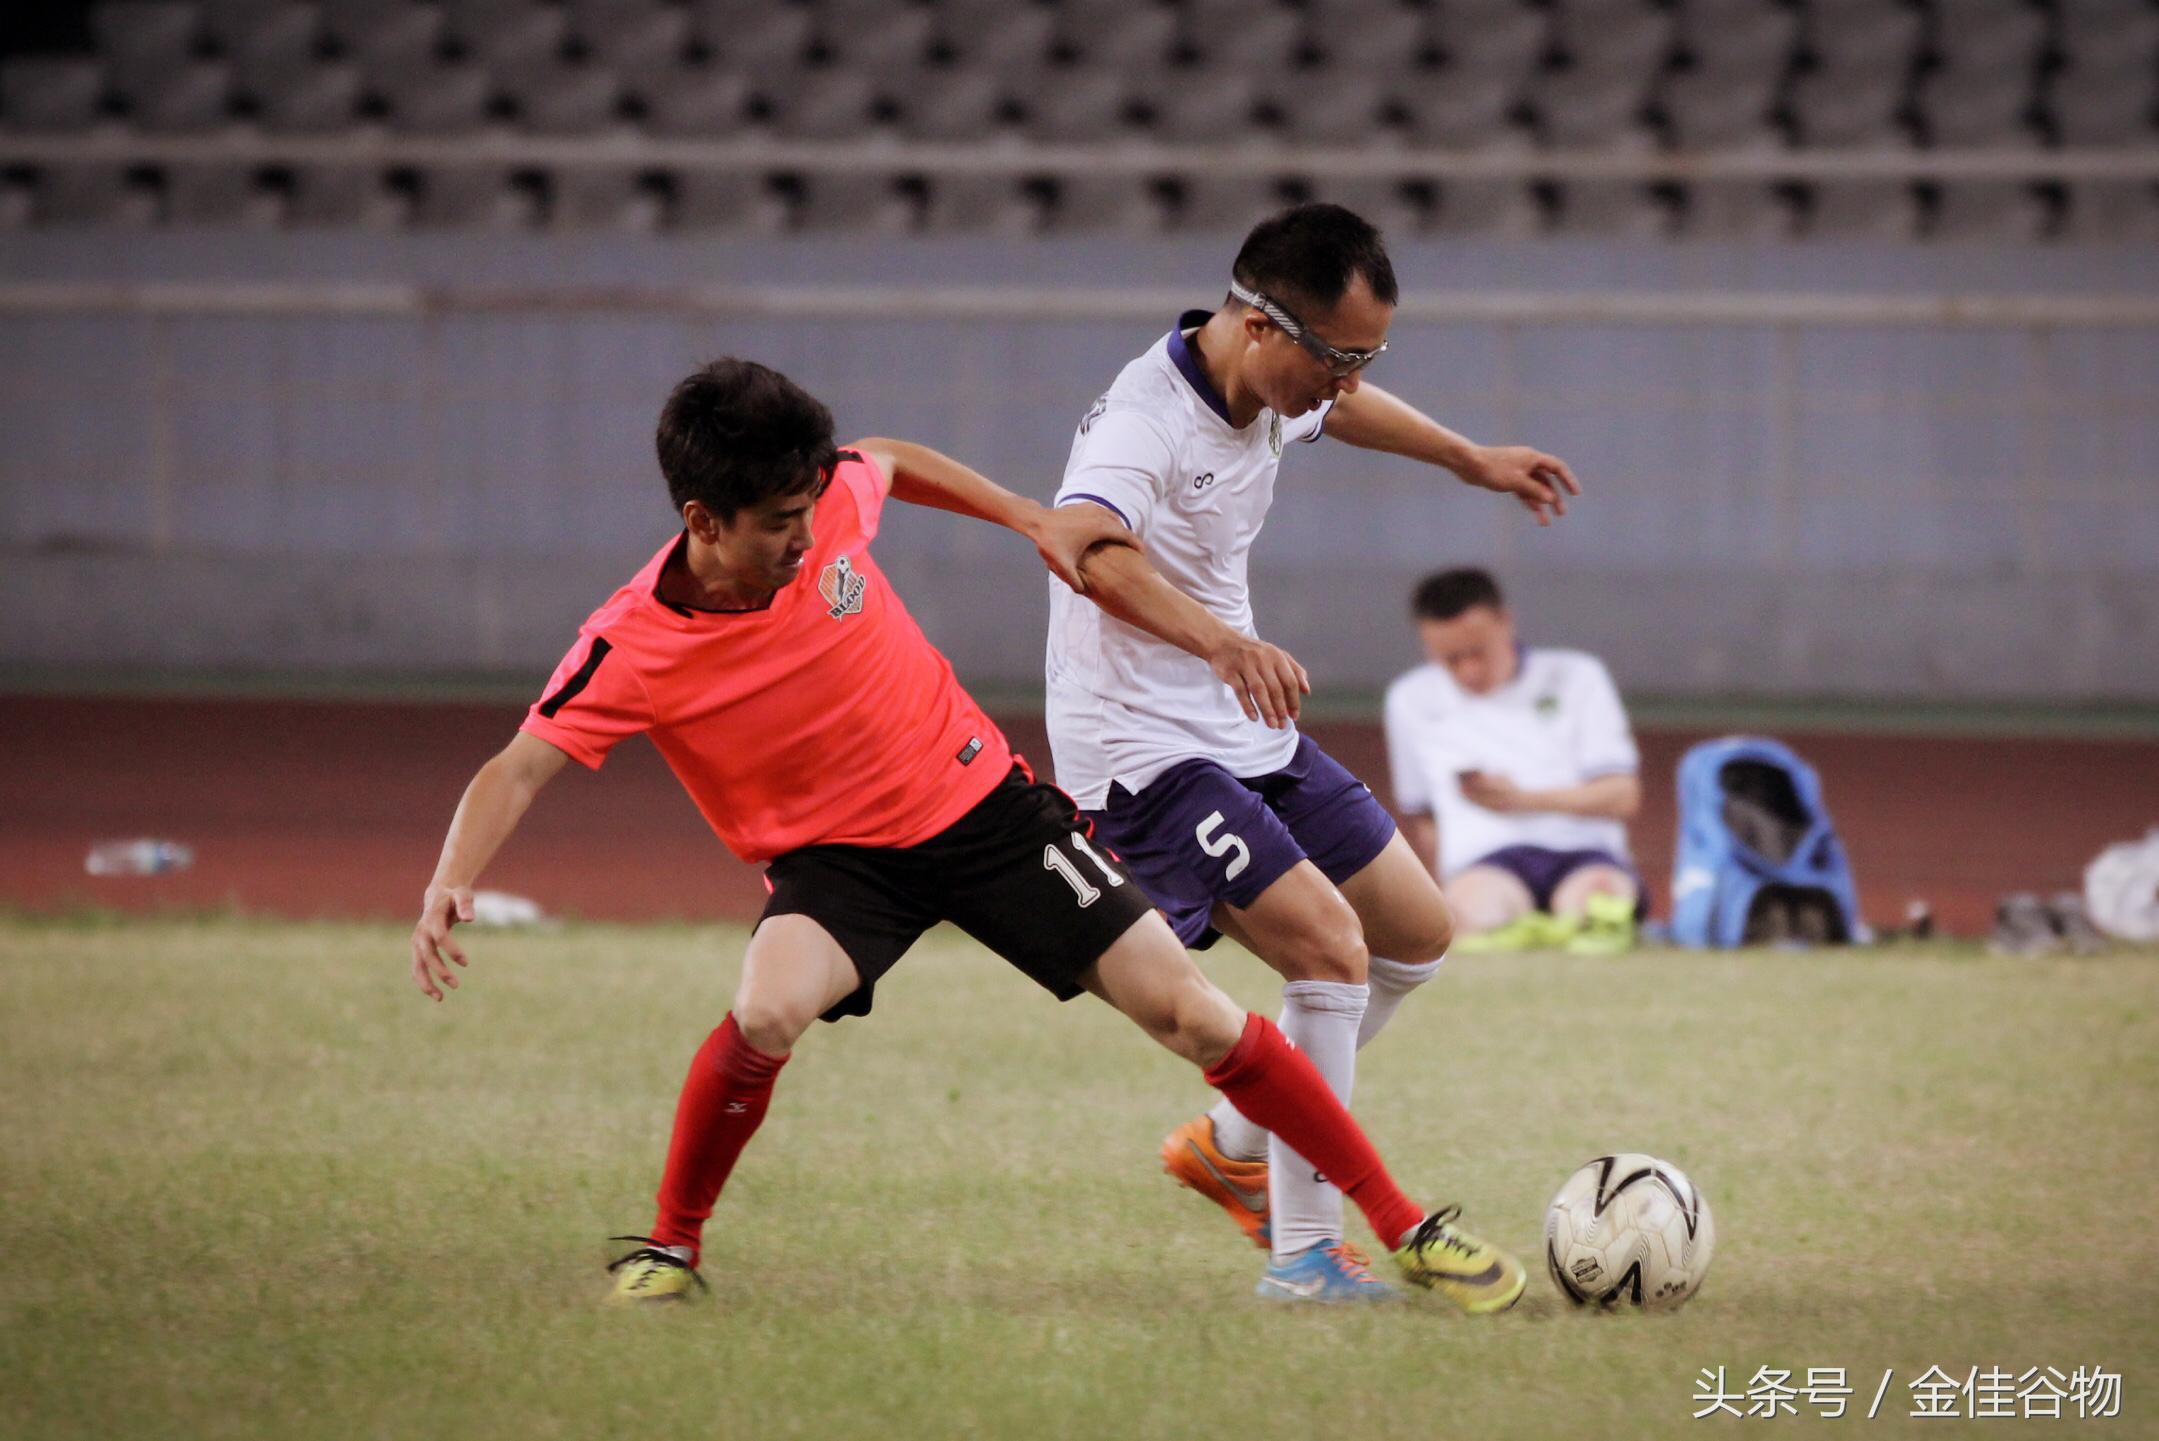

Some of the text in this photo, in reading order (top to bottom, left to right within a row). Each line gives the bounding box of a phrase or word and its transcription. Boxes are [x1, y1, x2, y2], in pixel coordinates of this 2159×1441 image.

[831, 576, 866, 617] BLOOD
[1044, 831, 1125, 908] 11
[1196, 810, 1251, 882] 5
